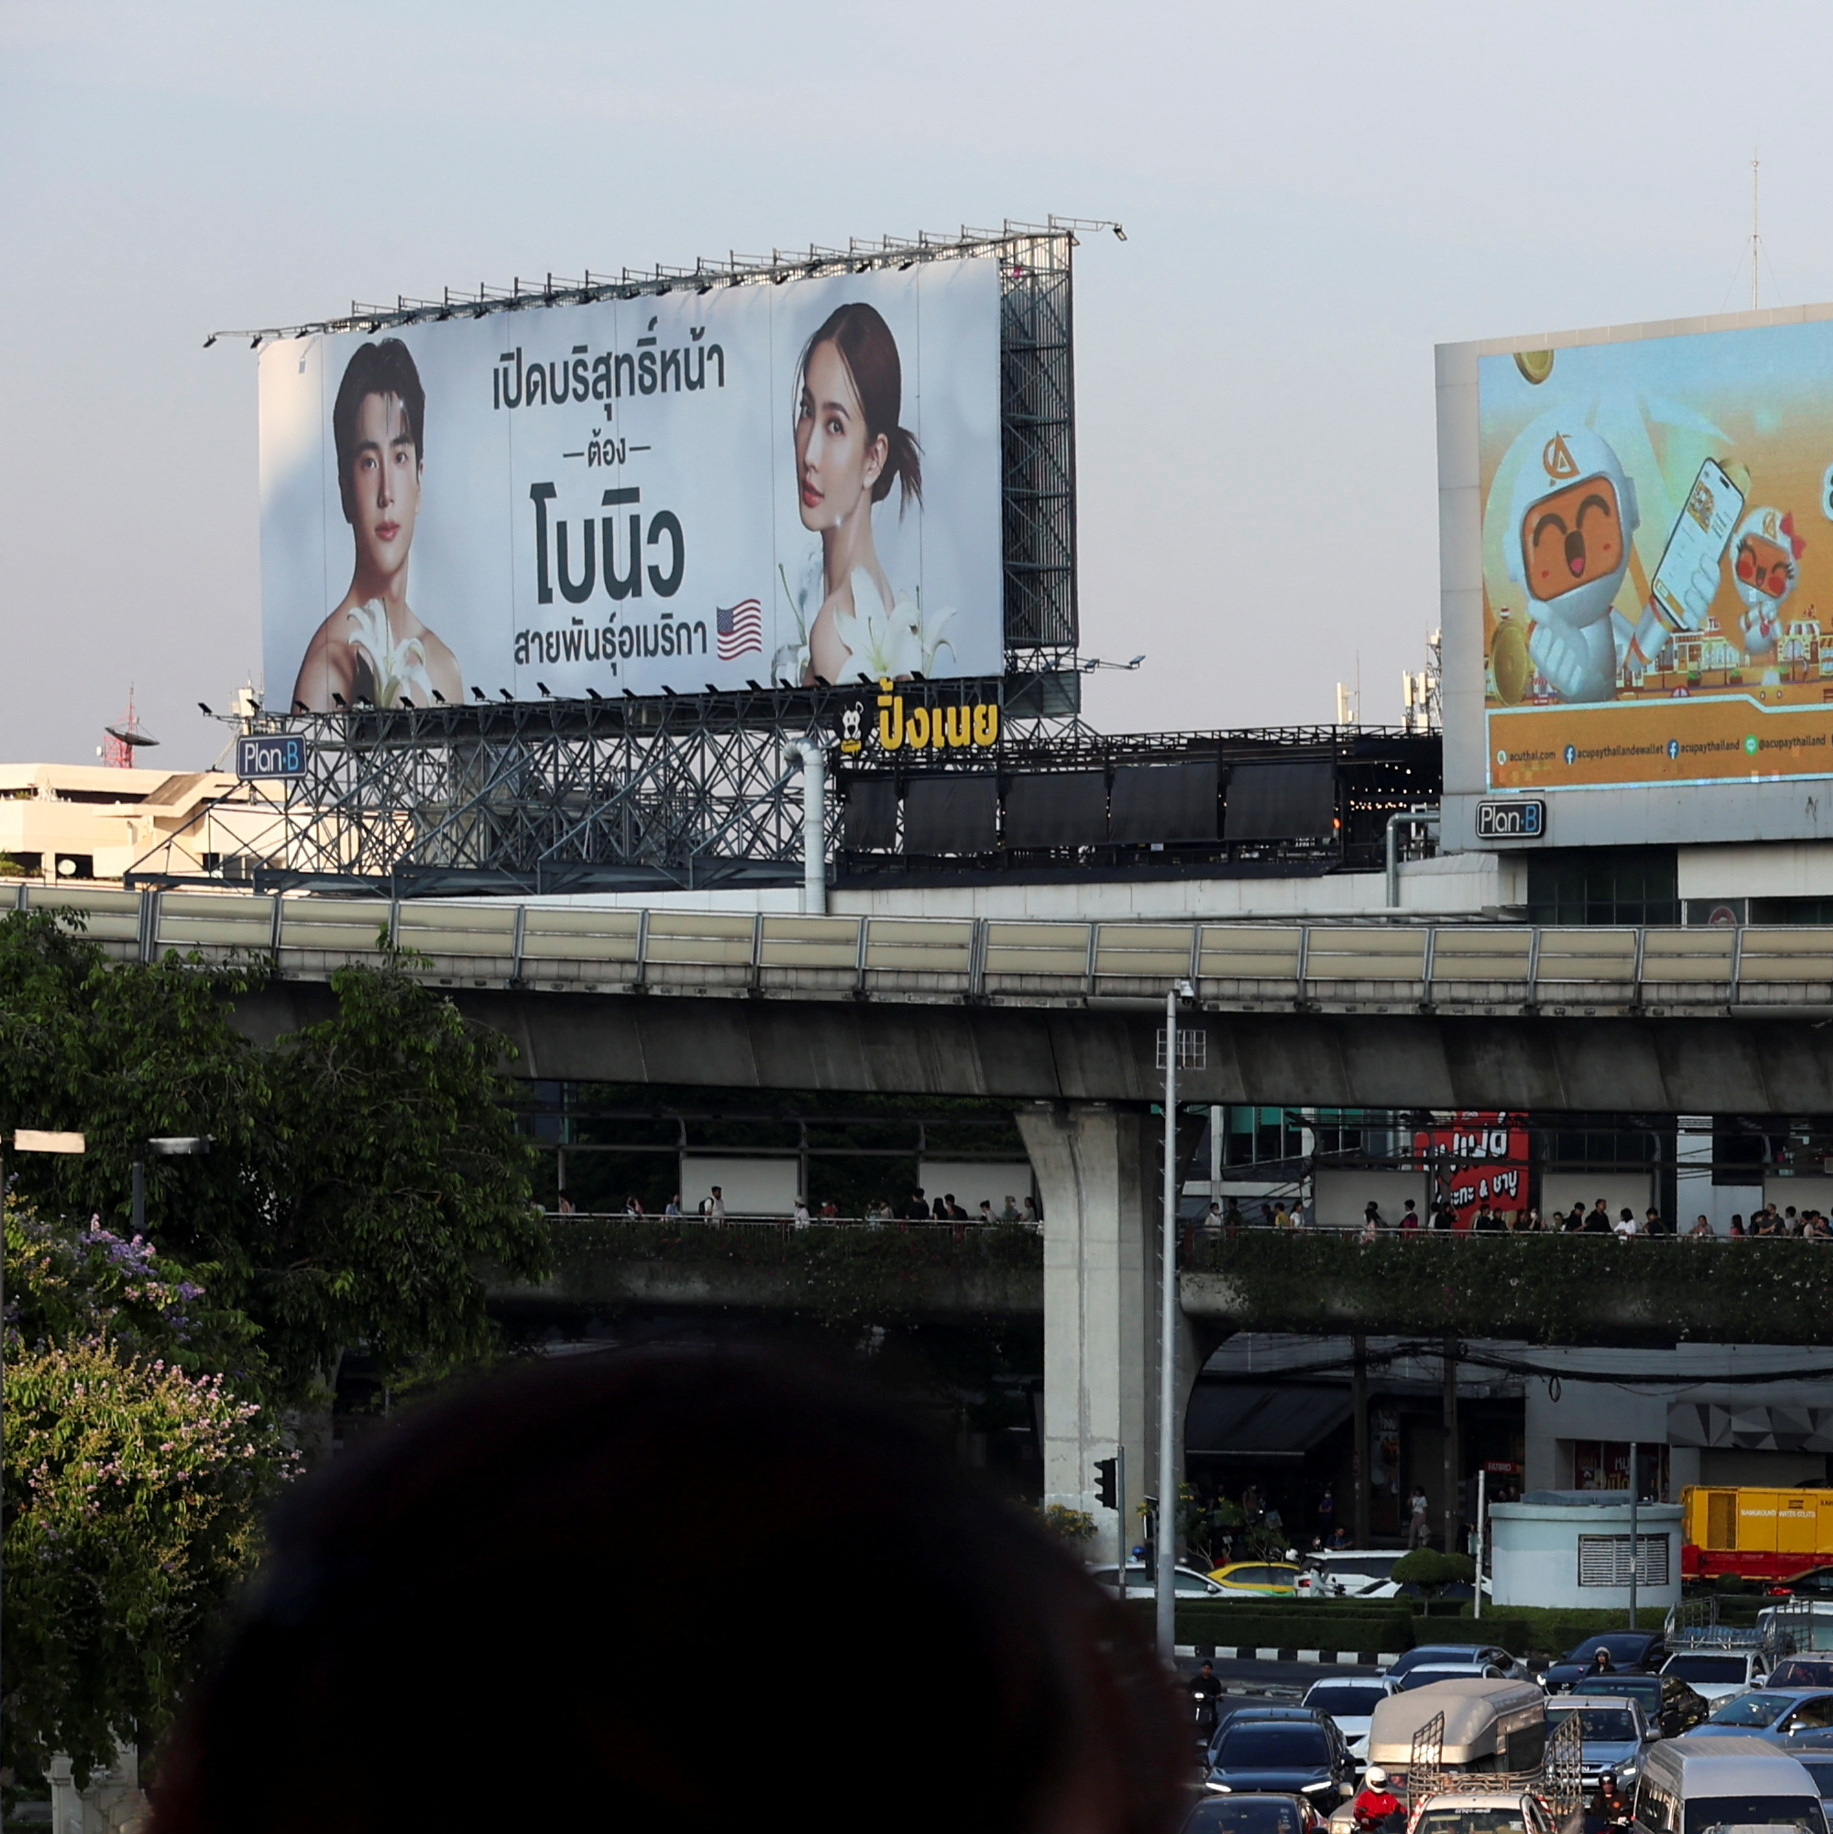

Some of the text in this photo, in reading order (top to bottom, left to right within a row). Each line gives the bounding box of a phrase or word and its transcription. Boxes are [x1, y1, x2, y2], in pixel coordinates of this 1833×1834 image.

[494, 316, 724, 421] เปิดบริสุทธิ์หน้า
[588, 428, 626, 467] ต้อง
[530, 482, 685, 604] โบนิว
[514, 612, 707, 677] สายพันธุ์อเมริกา
[877, 677, 998, 750] ปิ้งเนย
[1509, 751, 1555, 761] acuthai.com
[1680, 739, 1739, 754] acupaythailand
[1758, 736, 1826, 751] @acupaythailand
